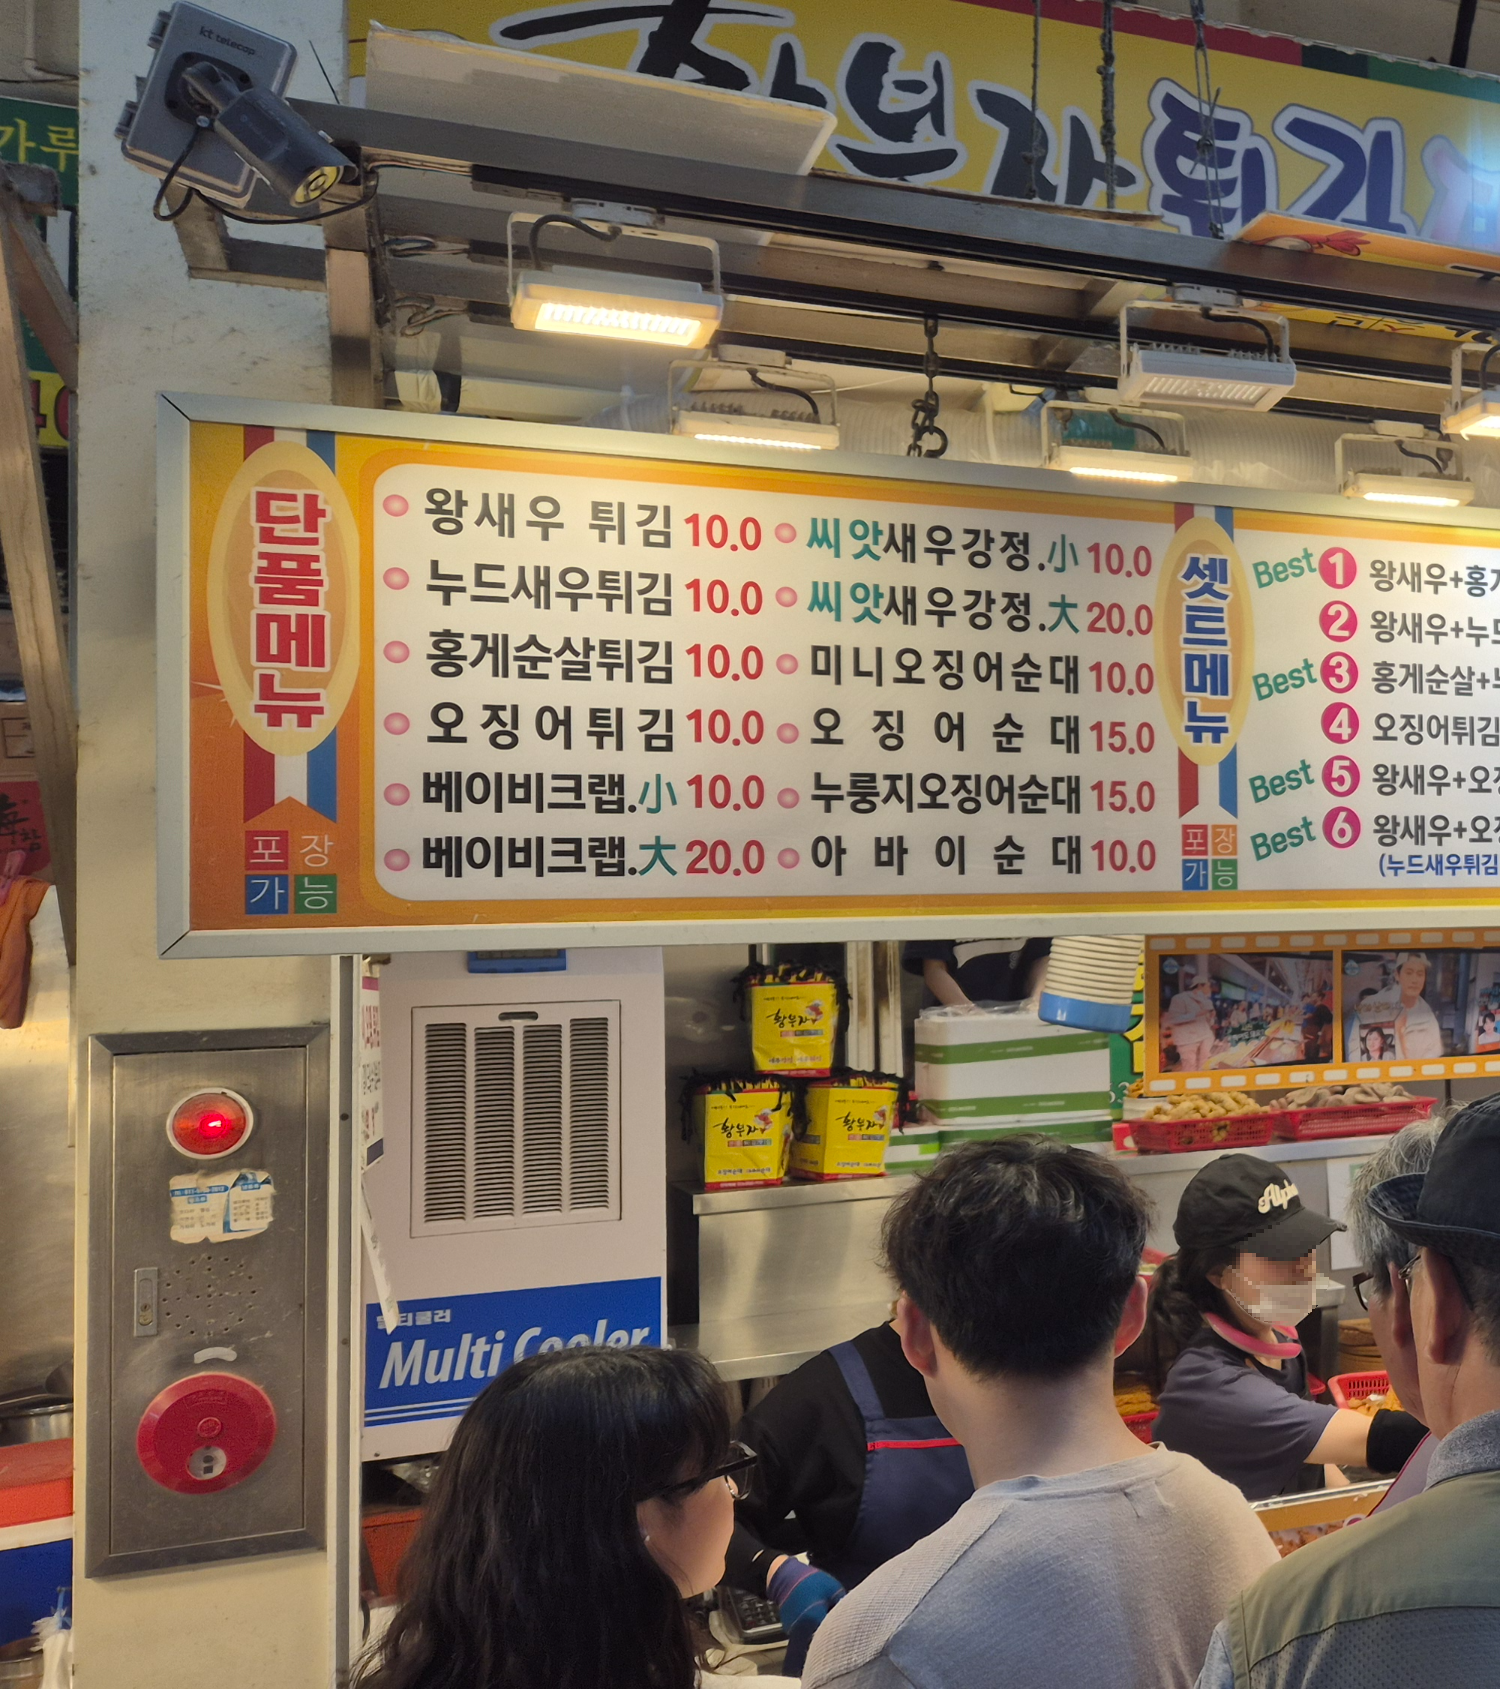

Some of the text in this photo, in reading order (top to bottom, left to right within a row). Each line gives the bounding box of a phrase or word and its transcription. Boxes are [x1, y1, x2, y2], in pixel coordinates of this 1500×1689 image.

[424, 488, 762, 551] 왕새우 튀김 10.0
[1088, 543, 1152, 577] 10.0
[1252, 548, 1317, 588] Best
[1330, 553, 1346, 585] 1
[253, 489, 327, 730] 단품메뉴
[426, 561, 763, 617] 누드새우튀김 10.0
[1087, 602, 1153, 636] 20.0
[1328, 605, 1349, 638] 2
[427, 629, 764, 684] 홍게순살튀김 10.0
[810, 645, 1154, 695] 미니오징어순대 10.0
[1182, 555, 1229, 744] 셋트메뉴
[1252, 658, 1317, 700] Best
[1328, 657, 1349, 688] 3
[427, 703, 764, 751] 오징어튀김 10.0
[1089, 721, 1155, 754] 15.0
[1328, 707, 1351, 740] 4
[423, 772, 765, 814] 베이비크랩.小 10.0
[810, 773, 1156, 814] 누룽지오징어순대 15.0
[1248, 759, 1315, 803] Best
[1330, 761, 1351, 792] 5
[250, 834, 334, 868] 포장
[423, 836, 765, 878] 베이비크랩.大 20.0
[1090, 839, 1156, 874] 10.0
[1184, 827, 1236, 855] 포장
[1250, 815, 1316, 861] Best
[1331, 812, 1352, 844] 6
[1184, 861, 1236, 888] 가능
[1378, 853, 1499, 877] (누드새우튀김
[250, 878, 333, 911] 가능
[378, 1330, 506, 1389] Multi
